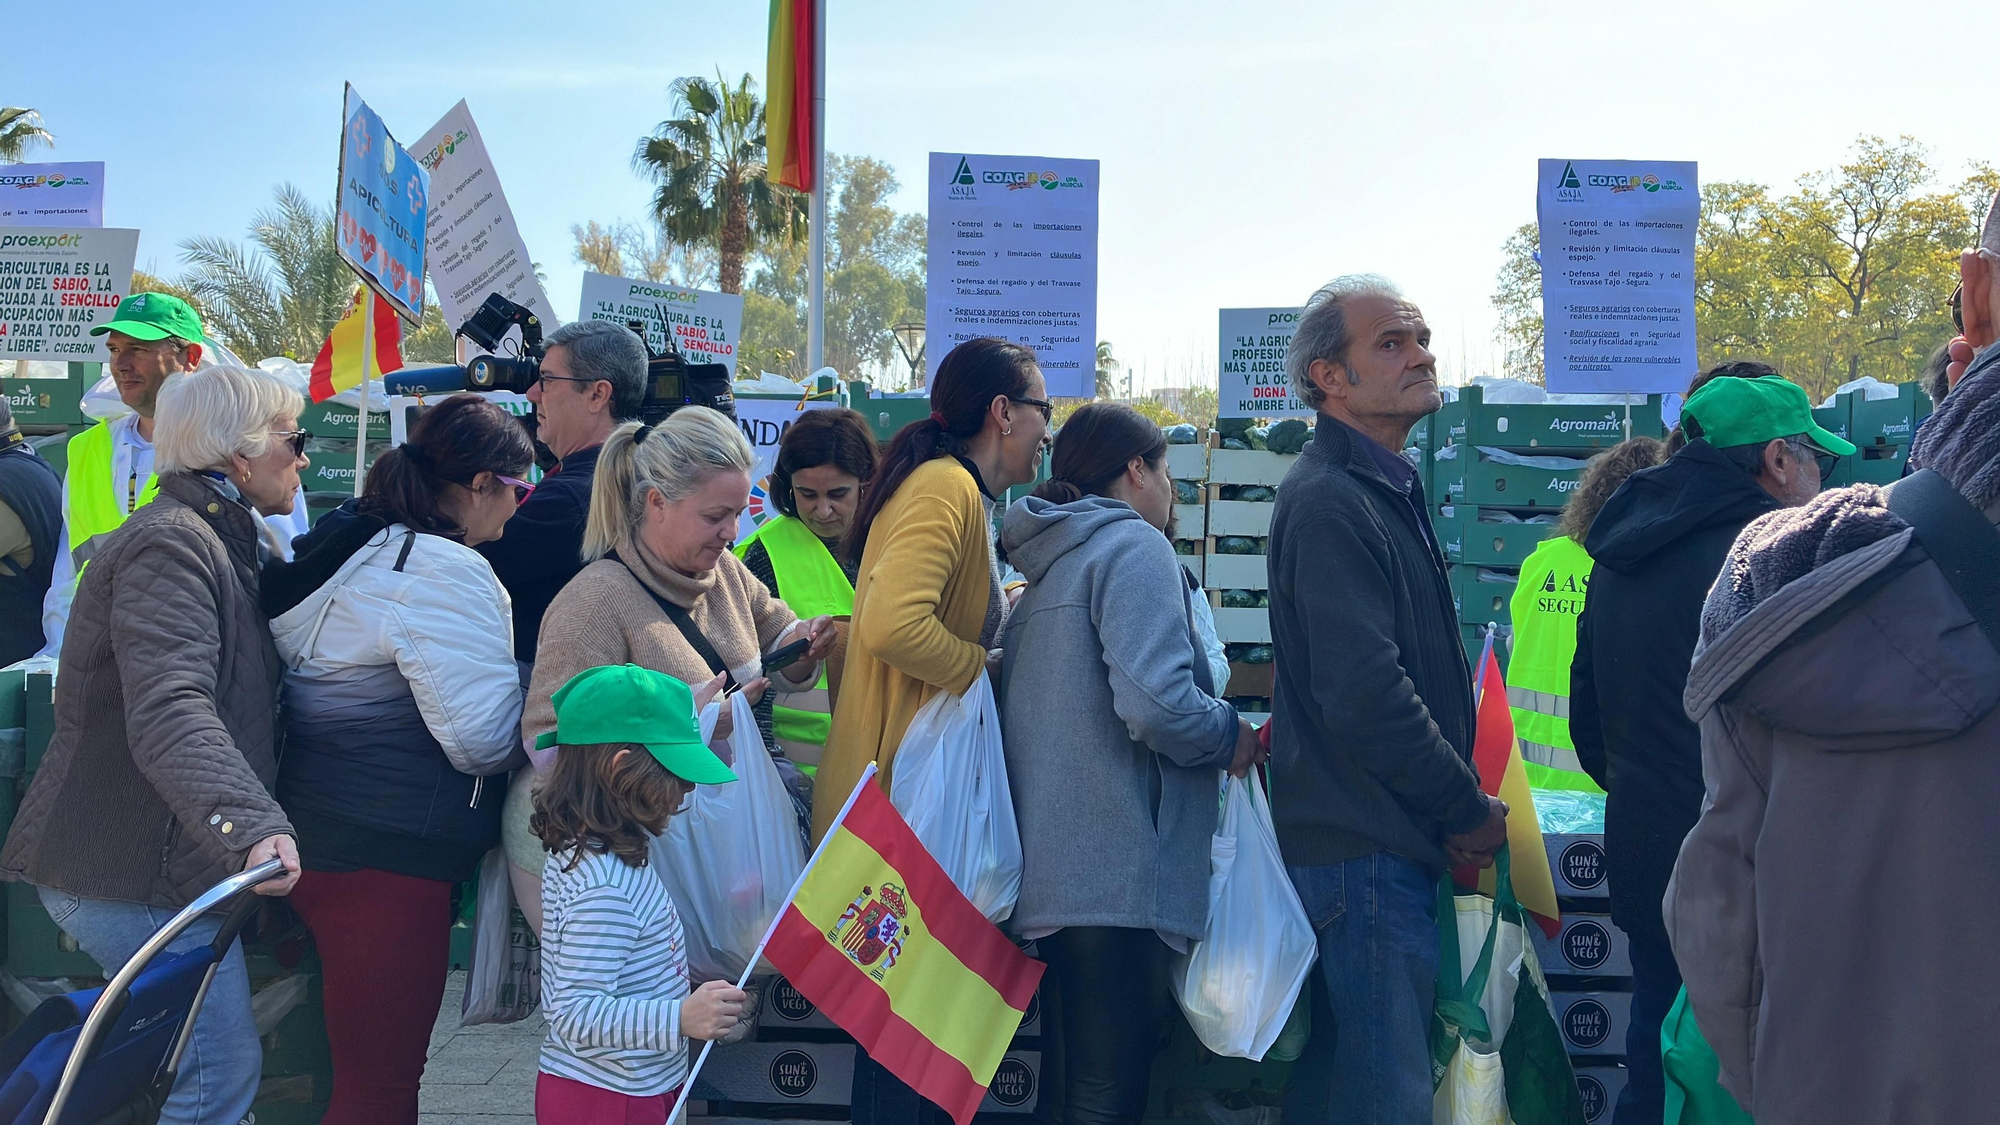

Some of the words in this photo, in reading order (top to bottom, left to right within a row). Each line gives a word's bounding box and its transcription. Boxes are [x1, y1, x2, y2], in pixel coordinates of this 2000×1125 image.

[455, 167, 483, 194] importaciones
[983, 171, 1025, 183] COAG
[1589, 175, 1627, 186] COAG
[950, 187, 975, 196] ASAJA
[1559, 190, 1582, 199] ASAJA
[349, 177, 418, 255] APICULTURA
[432, 228, 449, 244] Revisión
[454, 208, 474, 226] limitación
[473, 191, 493, 210] cláusulas
[1635, 221, 1683, 229] importaciones
[0, 234, 82, 249] proexport
[442, 252, 459, 268] Defensa
[494, 215, 502, 225] del
[74, 262, 90, 276] ES
[95, 263, 109, 276] LA
[445, 259, 463, 275] Trasvase
[462, 252, 472, 261] Tajo
[453, 282, 471, 299] Seguros
[470, 271, 489, 287] agrarios
[495, 248, 515, 267] coberturas
[1628, 271, 1653, 279] regadío
[26, 277, 47, 290] DEL
[52, 278, 91, 292] SABIO,
[97, 279, 112, 291] LA
[456, 293, 470, 305] reales
[474, 267, 506, 293] indemnizaciones
[506, 271, 525, 290] Seguridad
[41, 293, 55, 306] AL
[61, 293, 120, 307] SENCILLO
[629, 285, 699, 303] proexport
[68, 306, 94, 322] MÁS
[955, 308, 986, 316] Seguros
[988, 309, 1020, 317] agrarios
[1659, 314, 1680, 323] justas.
[694, 316, 706, 327] ES
[711, 319, 723, 329] LA
[987, 317, 1052, 326] indemnizaciones
[1053, 318, 1080, 327] justas.
[12, 324, 42, 337] PARA
[49, 324, 80, 337] TODO
[676, 326, 709, 341] SABIO,
[714, 331, 726, 342] LA
[1570, 330, 1620, 338] Bonificaciones
[1648, 331, 1681, 339] Seguridad
[54, 342, 95, 354] CICERÓN
[684, 339, 733, 355] SENCILLO
[691, 351, 712, 364] MÁS
[1224, 360, 1246, 372] MÁS
[1244, 375, 1250, 385] Y
[1256, 375, 1268, 385] LA
[395, 383, 428, 394] tve
[1253, 387, 1287, 398] DIGNA
[1239, 400, 1284, 411] HOMBRE
[1550, 418, 1620, 432] Agromark
[1882, 423, 1910, 435] Agromark
[1548, 478, 1581, 492] Agro
[1538, 598, 1585, 614] SEGU
[1571, 867, 1597, 879] VEGS
[1573, 946, 1599, 958] VEGS
[781, 987, 800, 998] SUN
[782, 999, 807, 1010] VEGS
[1573, 1026, 1599, 1037] VEGS
[781, 1076, 806, 1087] VEGS
[998, 1084, 1023, 1096] VEGS
